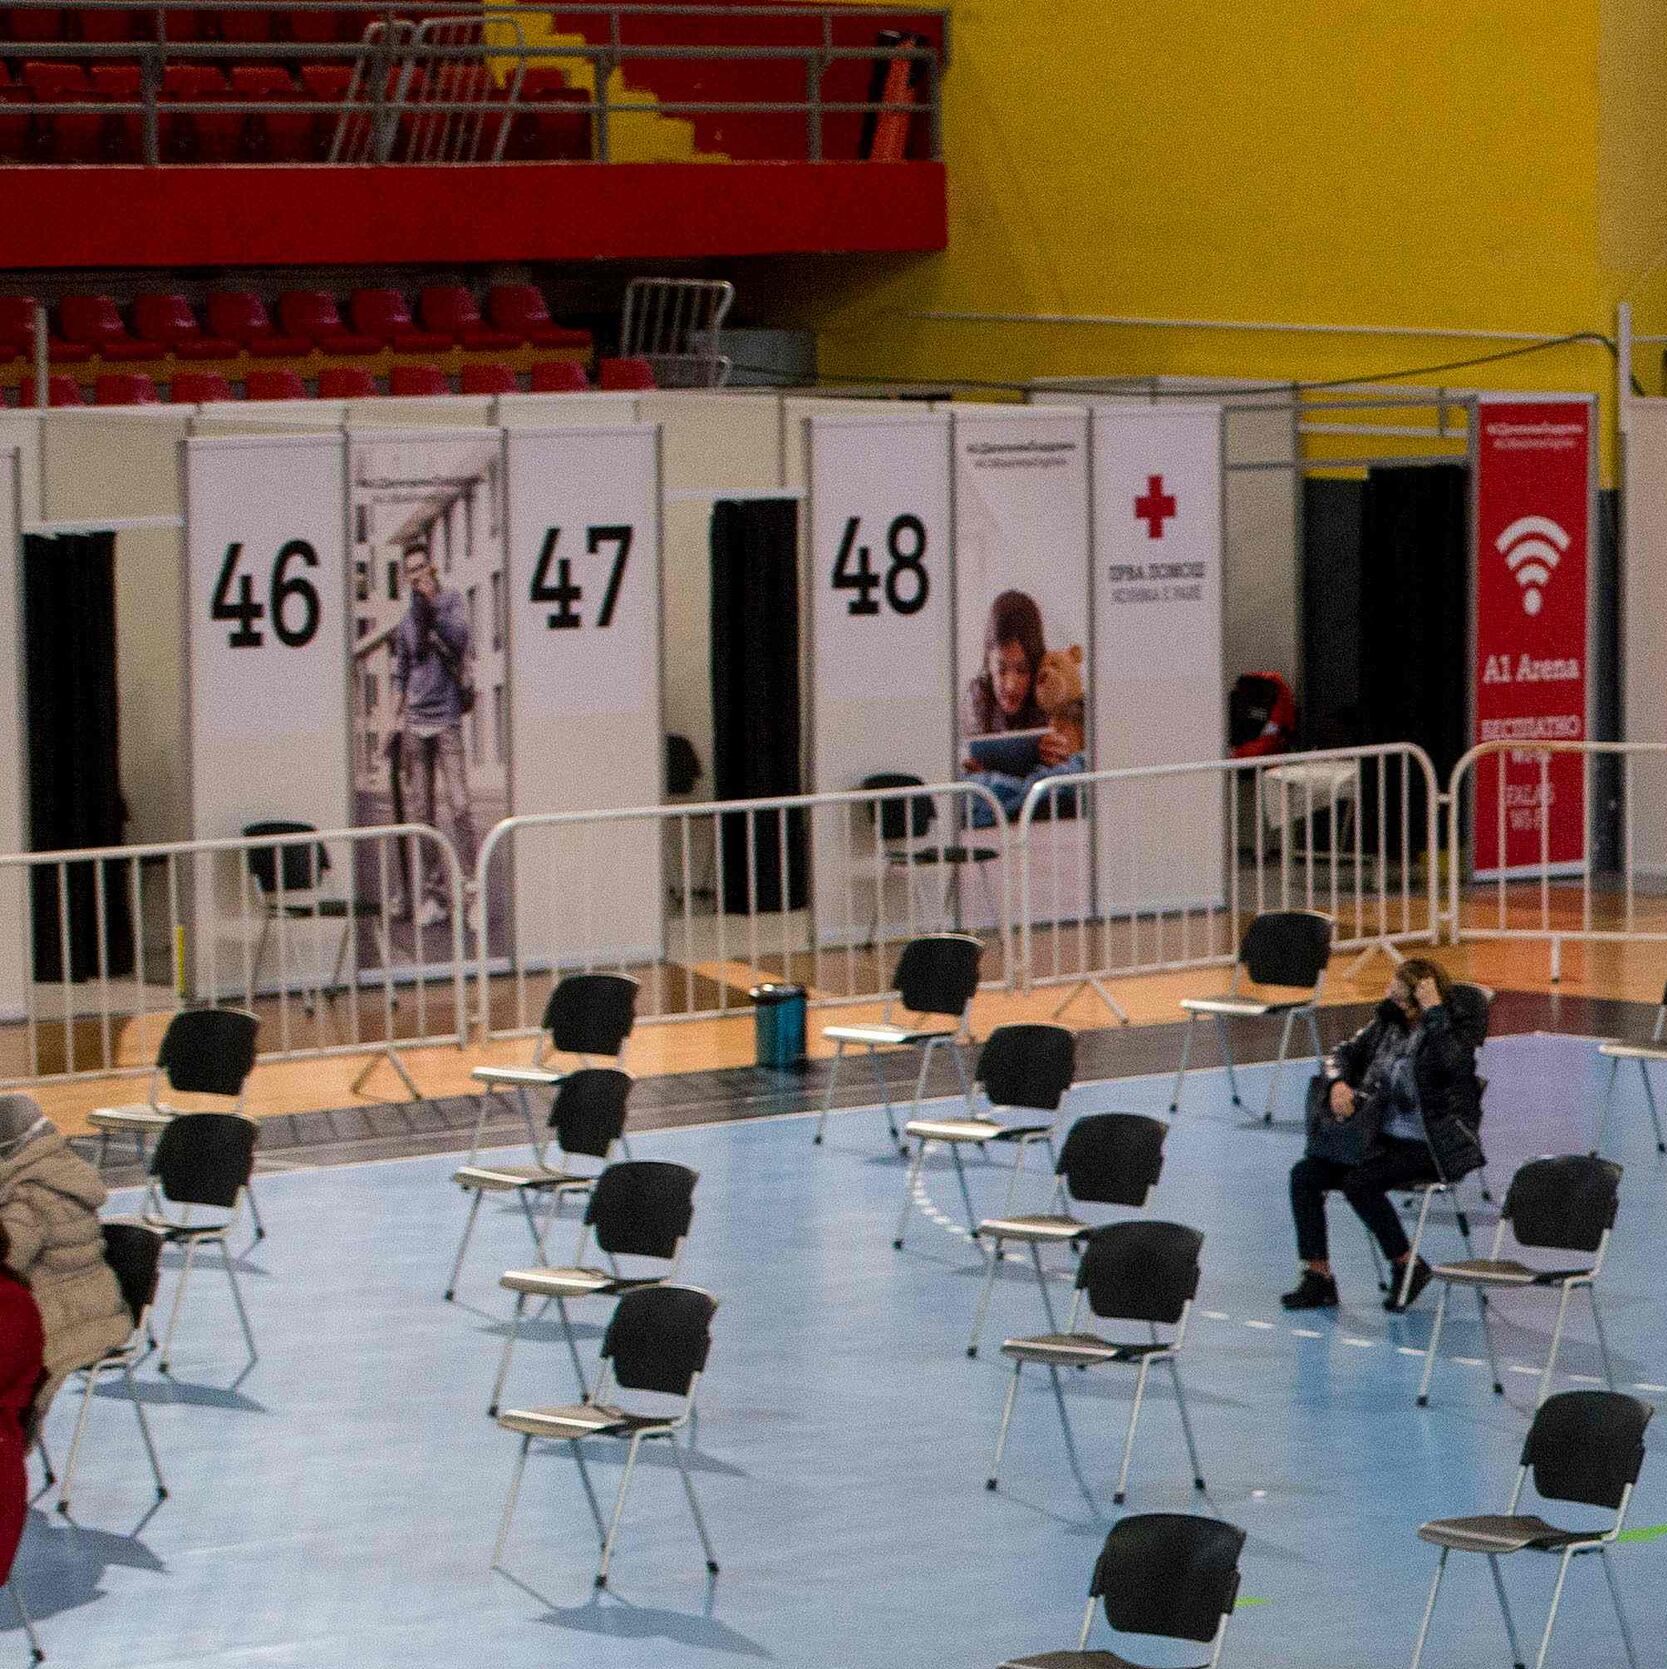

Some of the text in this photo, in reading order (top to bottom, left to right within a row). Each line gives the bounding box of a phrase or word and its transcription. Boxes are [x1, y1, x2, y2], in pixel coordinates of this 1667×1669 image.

[209, 539, 320, 648] 46
[529, 524, 634, 629] 47
[831, 513, 929, 615] 48
[1483, 654, 1511, 684] A1
